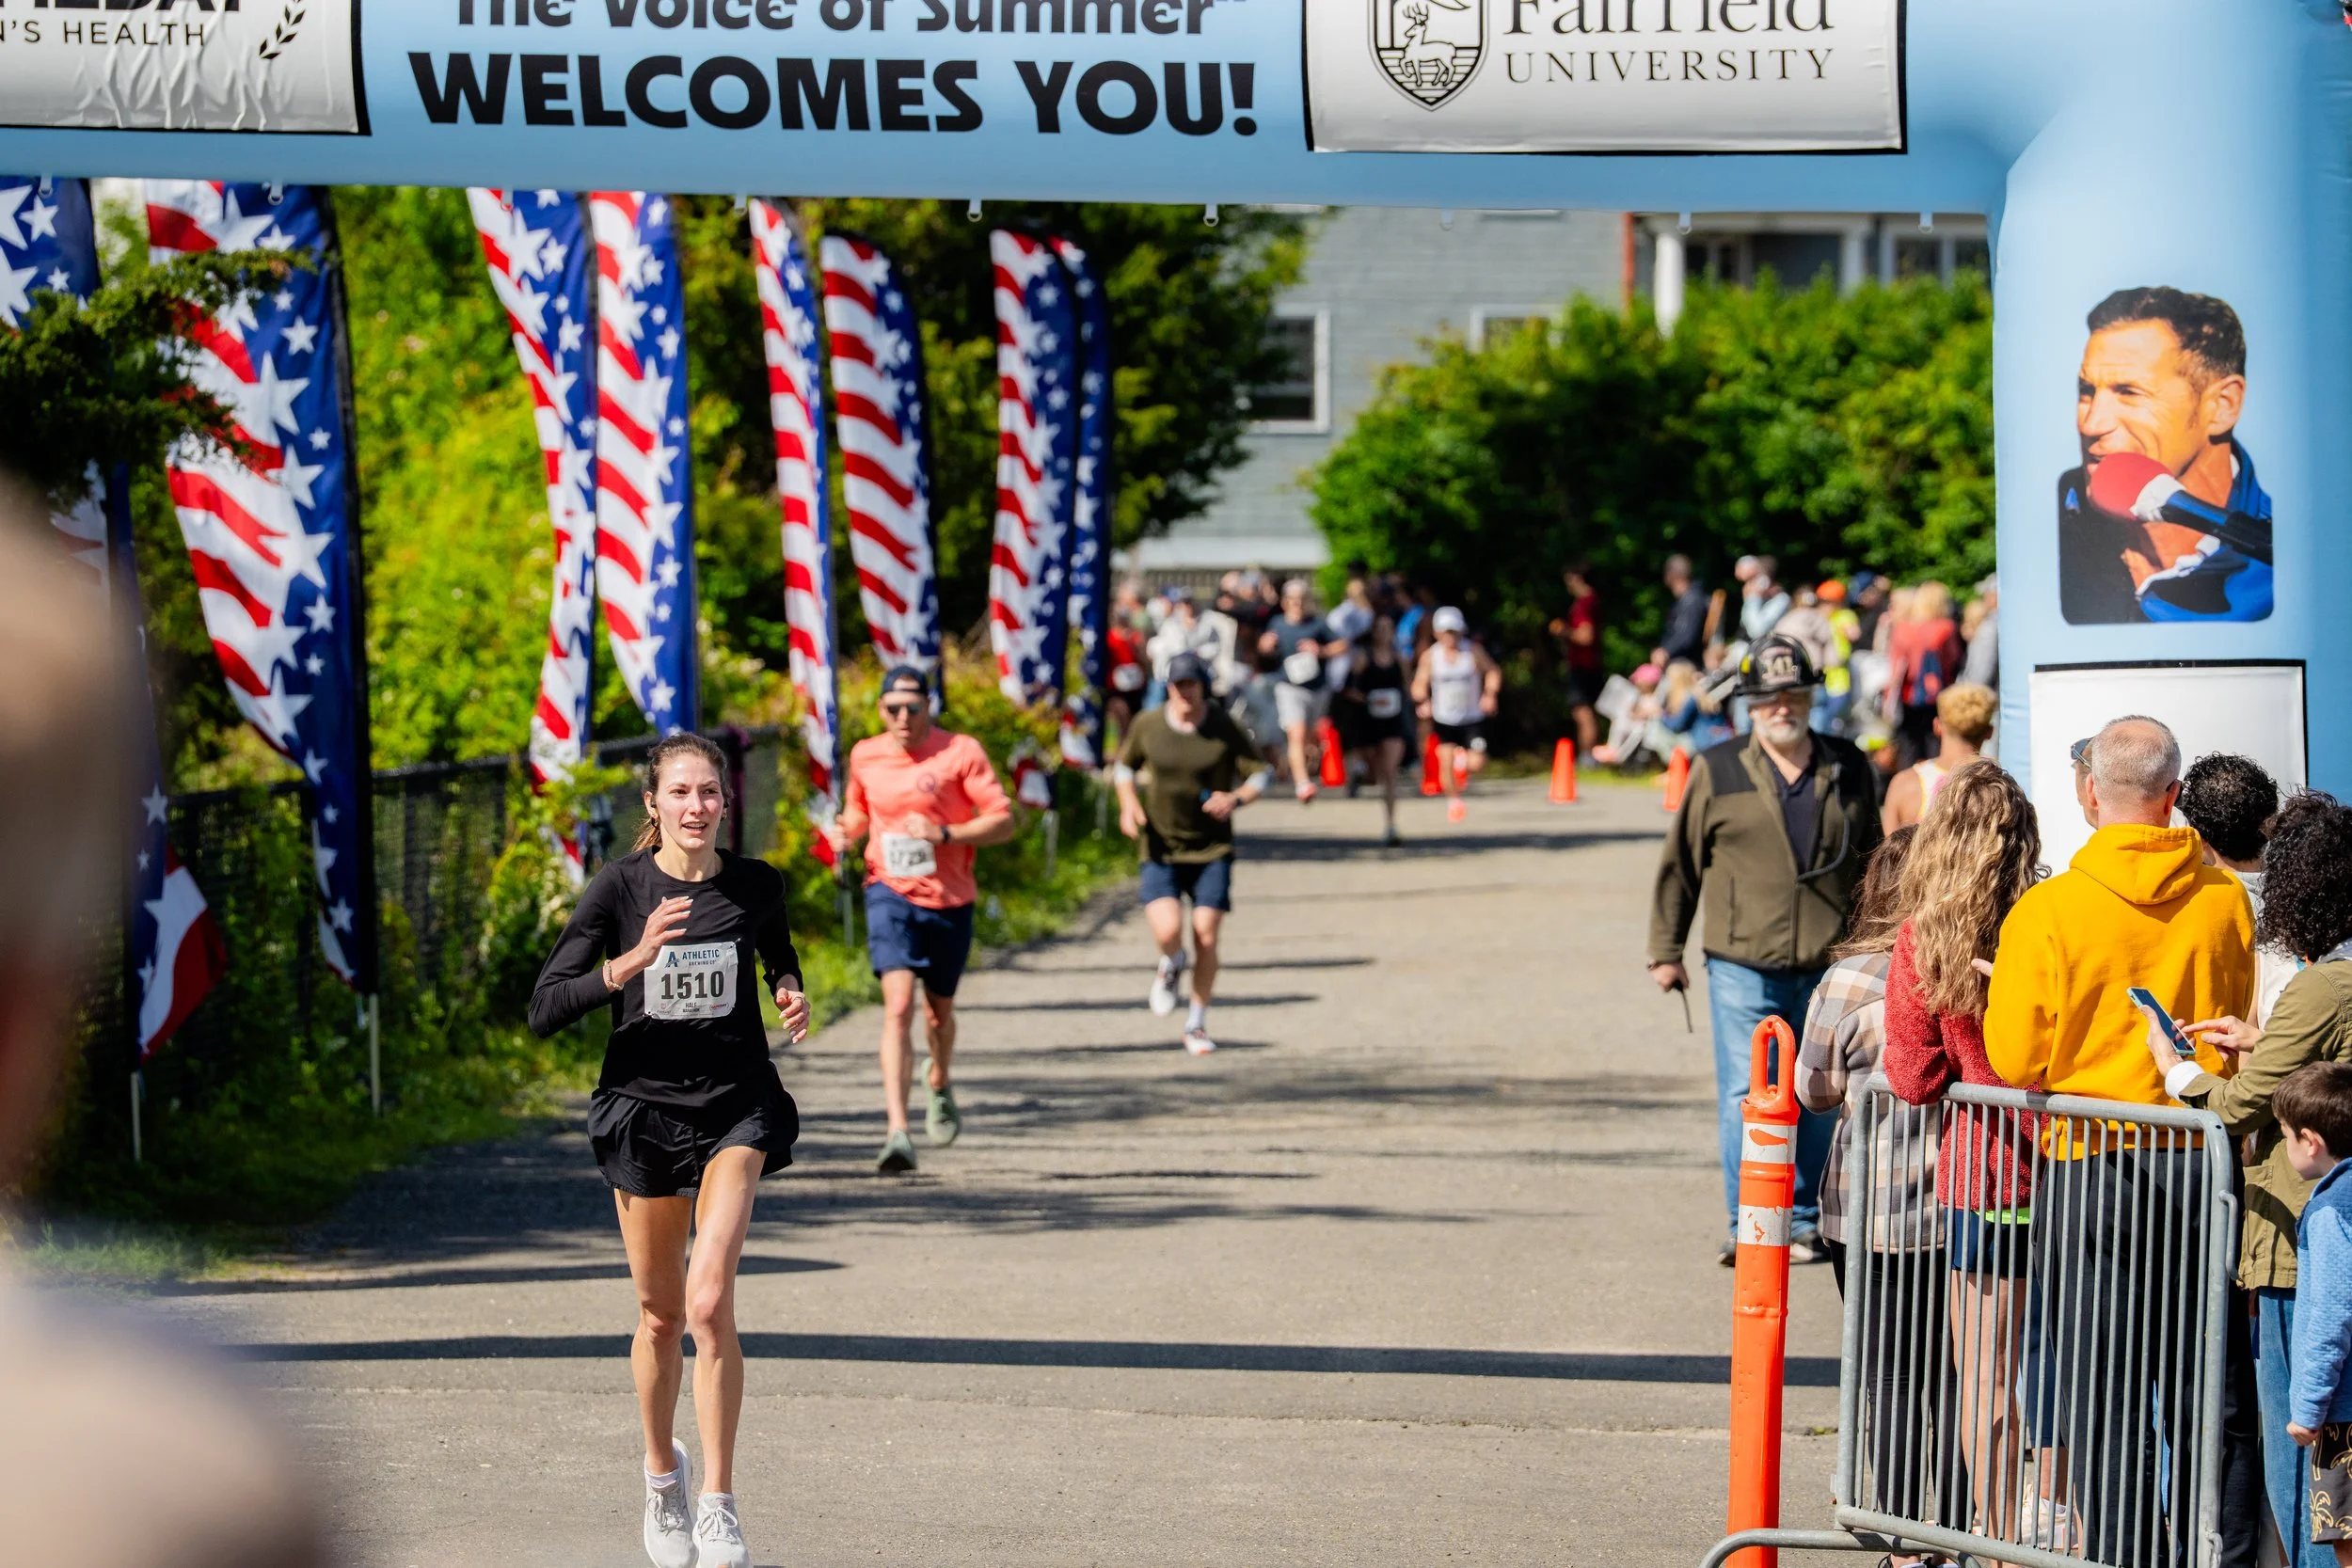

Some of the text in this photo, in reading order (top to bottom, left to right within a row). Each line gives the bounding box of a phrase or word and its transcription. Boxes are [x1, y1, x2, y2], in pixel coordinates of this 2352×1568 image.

[63, 22, 205, 46] HEALTH
[1504, 48, 1835, 83] UNIVERSITY
[406, 52, 1258, 136] WELCOMES YOU!
[682, 949, 720, 960] ATHLETIC
[660, 971, 724, 1000] 1510
